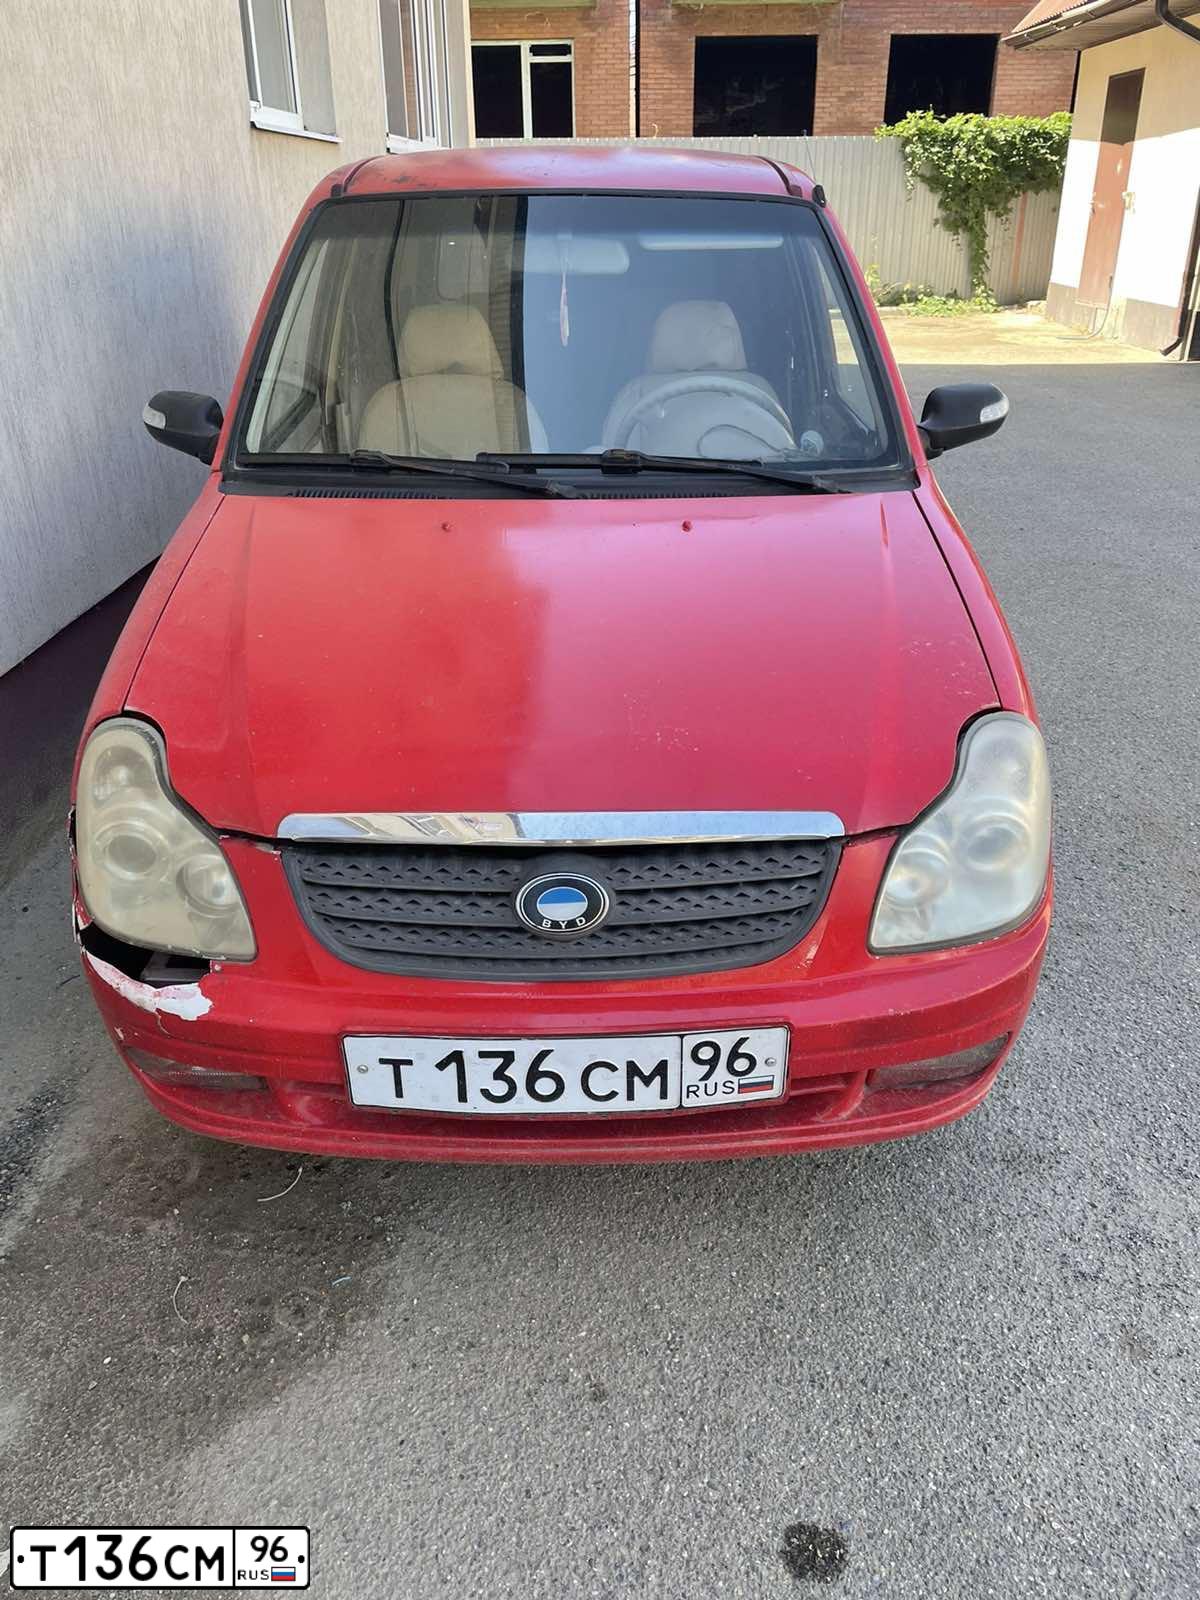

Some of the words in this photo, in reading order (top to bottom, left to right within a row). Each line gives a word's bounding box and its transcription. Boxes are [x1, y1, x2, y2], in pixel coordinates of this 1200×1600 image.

[541, 917, 586, 929] BYD
[690, 1037, 757, 1082] 96
[686, 1082, 735, 1099] RUS
